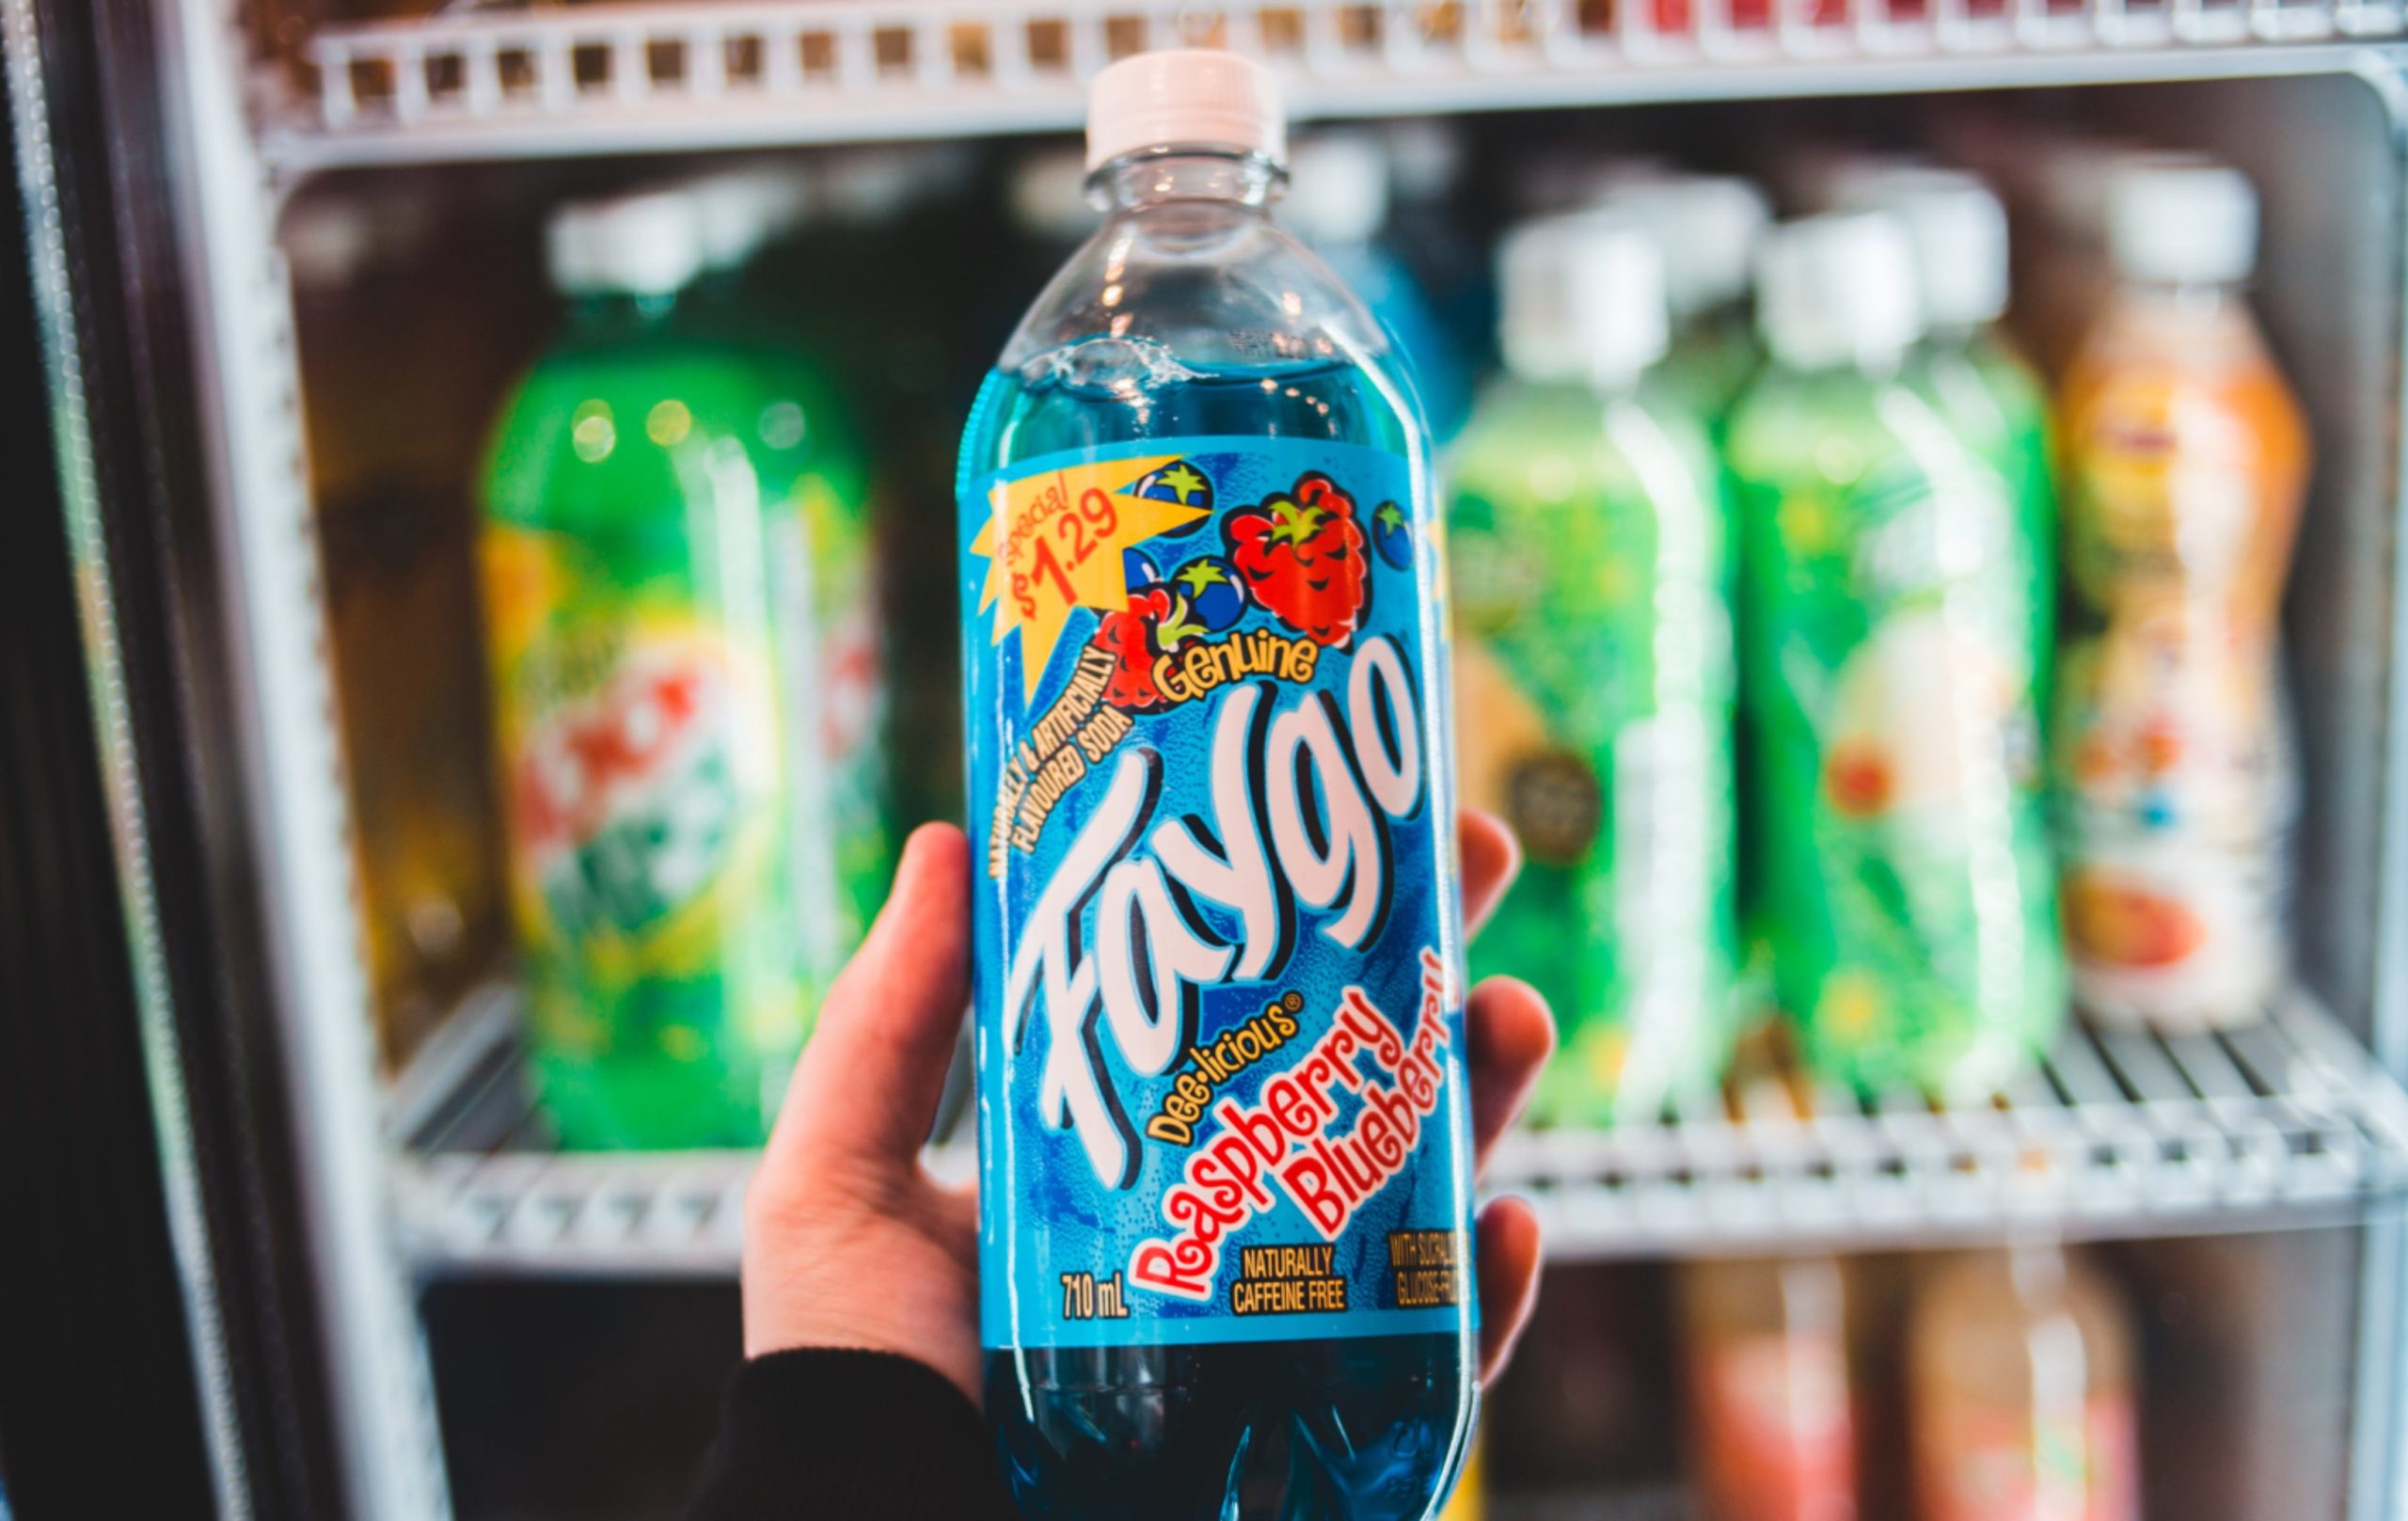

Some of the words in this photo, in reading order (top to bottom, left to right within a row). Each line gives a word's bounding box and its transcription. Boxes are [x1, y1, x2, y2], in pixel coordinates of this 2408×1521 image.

[1011, 487, 1118, 622] $1.29
[1152, 628, 1319, 703] Genuine
[989, 756, 1029, 878] NATURALLY
[1019, 740, 1040, 772] &
[1032, 646, 1117, 759] ARTIFICIALLY
[1012, 744, 1085, 853] FLAVOURED
[1077, 704, 1133, 763] SODA
[1008, 636, 1421, 1189] Faygo
[1133, 990, 1402, 1295] Raspberry
[1061, 1274, 1093, 1317] 710
[1098, 1273, 1128, 1317] mL
[1234, 1281, 1307, 1313] CAFFEINE
[1308, 1280, 1345, 1310] FREE
[1243, 1246, 1334, 1278] NATURALLY
[1389, 1233, 1416, 1266] WITH
